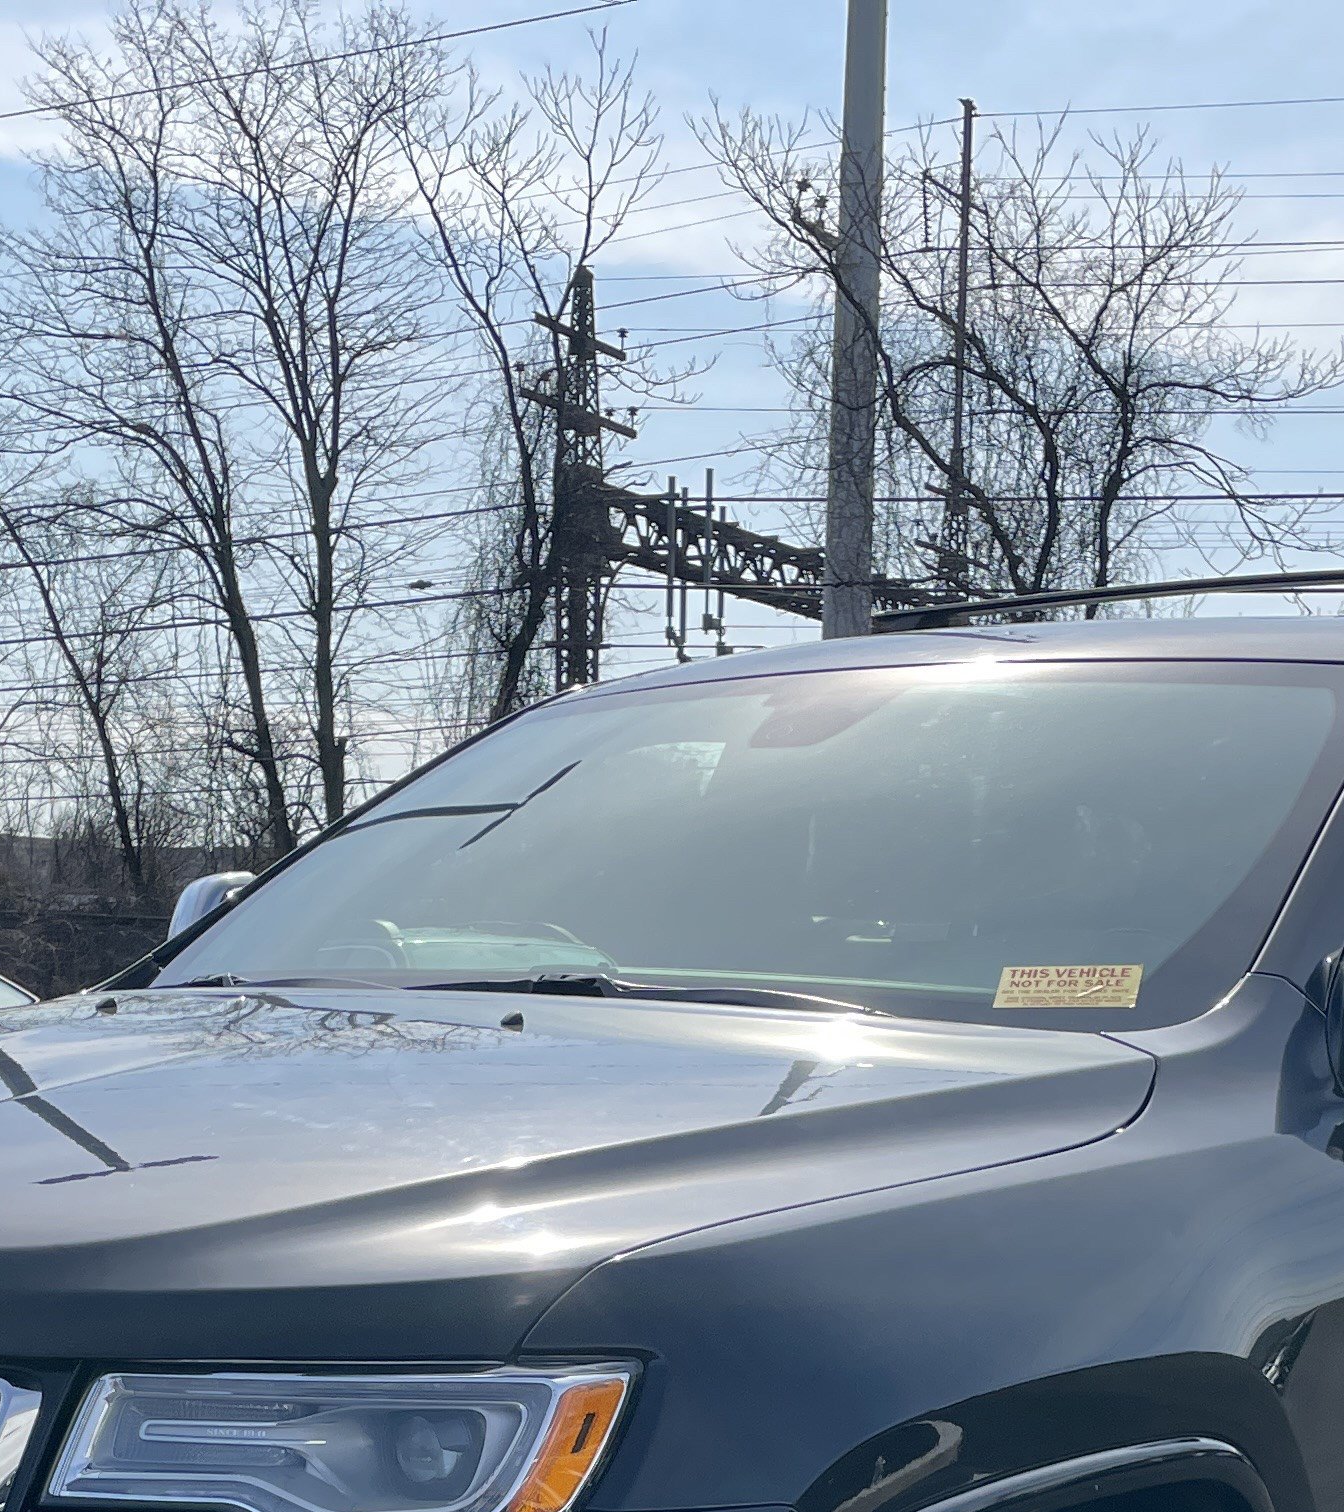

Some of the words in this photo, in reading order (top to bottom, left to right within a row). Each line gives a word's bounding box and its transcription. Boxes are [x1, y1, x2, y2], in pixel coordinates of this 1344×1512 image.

[1009, 968, 1050, 979] THIS
[1056, 967, 1132, 978] VEHICLE
[1009, 979, 1041, 988] NOT
[1047, 979, 1079, 988] FOR
[1084, 979, 1125, 987] SALE
